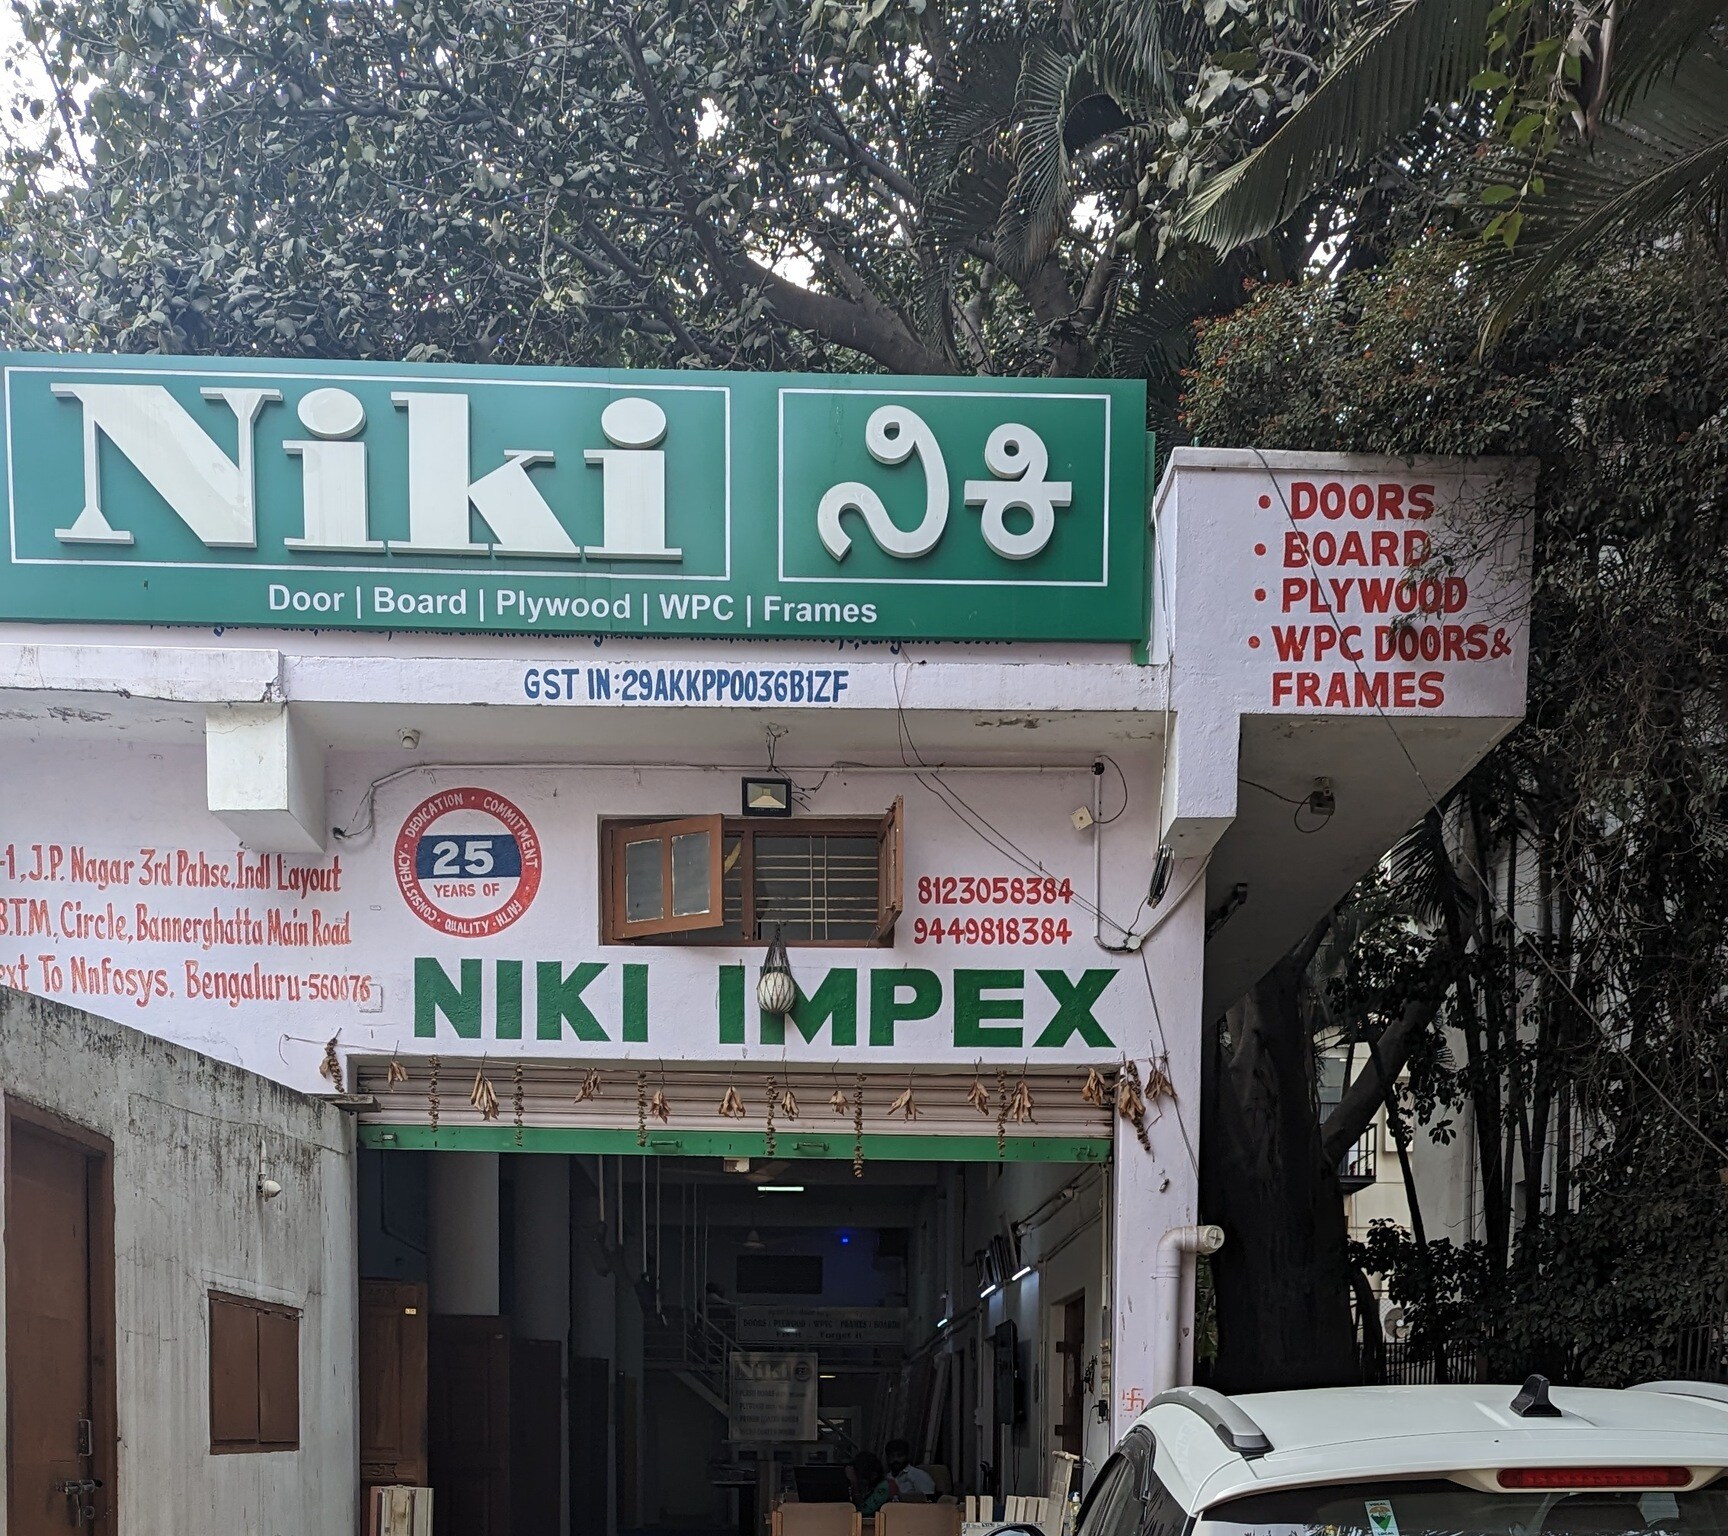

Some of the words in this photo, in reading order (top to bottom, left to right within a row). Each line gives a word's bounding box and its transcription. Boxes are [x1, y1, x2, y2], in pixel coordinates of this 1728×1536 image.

[50, 383, 683, 561] Niki
[817, 404, 1072, 562] ನಿಕಿ
[1290, 482, 1436, 521] DOORS
[1283, 530, 1432, 568] BOARD
[269, 584, 345, 612] Door
[374, 586, 467, 615] Board
[497, 589, 631, 623] Plywood
[659, 593, 735, 621] WPC
[764, 595, 878, 623] Frames
[1281, 577, 1468, 614] PLYWOOD
[1271, 625, 1364, 663] WPC
[524, 668, 580, 700] GST
[1272, 671, 1445, 709] FRAMES
[405, 793, 464, 838] DEDICATION
[483, 796, 539, 869] COMMITMENT
[71, 846, 135, 891] Nagar
[138, 849, 173, 886] 3rd
[277, 853, 342, 900] Layout
[432, 840, 495, 876] 25
[398, 850, 438, 923] CONSISTENCY
[433, 884, 477, 898] YEARS
[482, 882, 500, 897] OF
[917, 876, 1074, 905] 8123058384
[136, 903, 264, 951] Bannerghatta
[267, 908, 309, 947] Main
[312, 909, 352, 947] Road
[444, 918, 490, 935] QUALITY
[495, 899, 523, 927] FAITH
[913, 917, 1073, 946] 9449818384
[38, 955, 63, 993] To
[413, 957, 649, 1043] NIKI
[718, 964, 1122, 1049] IMPEX
